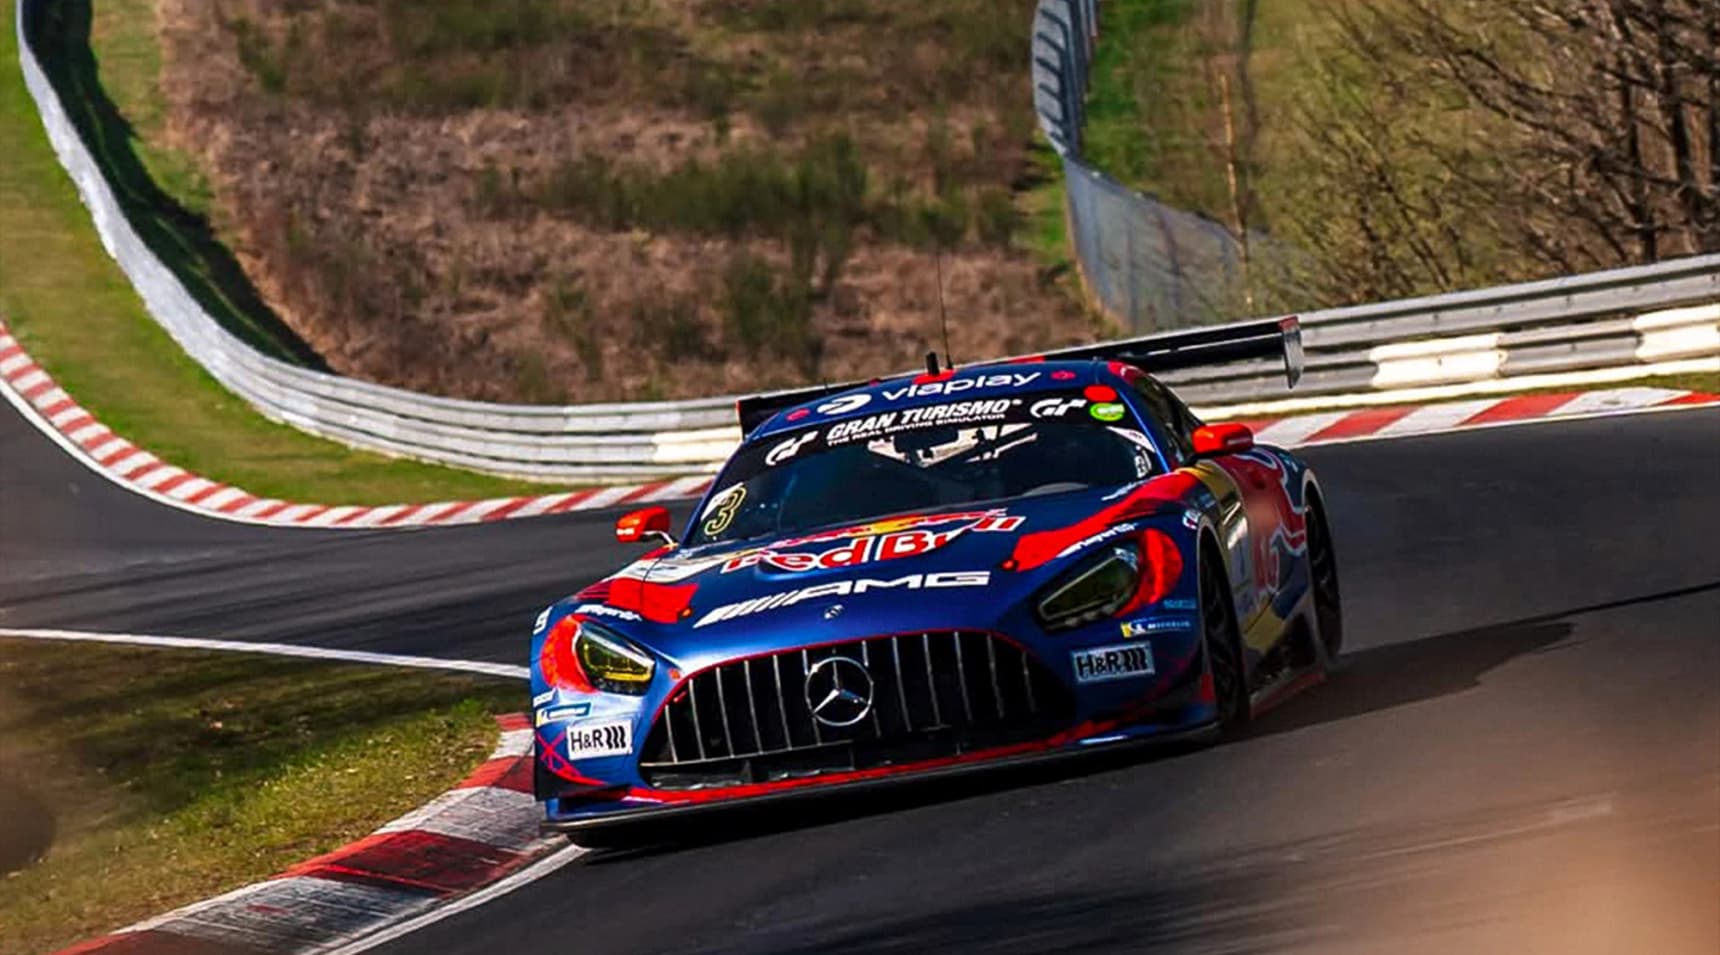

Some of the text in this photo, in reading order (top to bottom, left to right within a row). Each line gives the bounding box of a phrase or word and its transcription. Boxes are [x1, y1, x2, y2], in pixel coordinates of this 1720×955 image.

[882, 372, 1041, 401] viaplay
[826, 399, 1012, 441] GRAN TURISMO
[827, 413, 1006, 447] THE REAL DRIVING SIMULATOR
[704, 487, 747, 536] 3
[873, 515, 1026, 561] Bll
[788, 571, 991, 604] AMG
[1076, 650, 1124, 676] H&R
[570, 728, 604, 751] H&R
